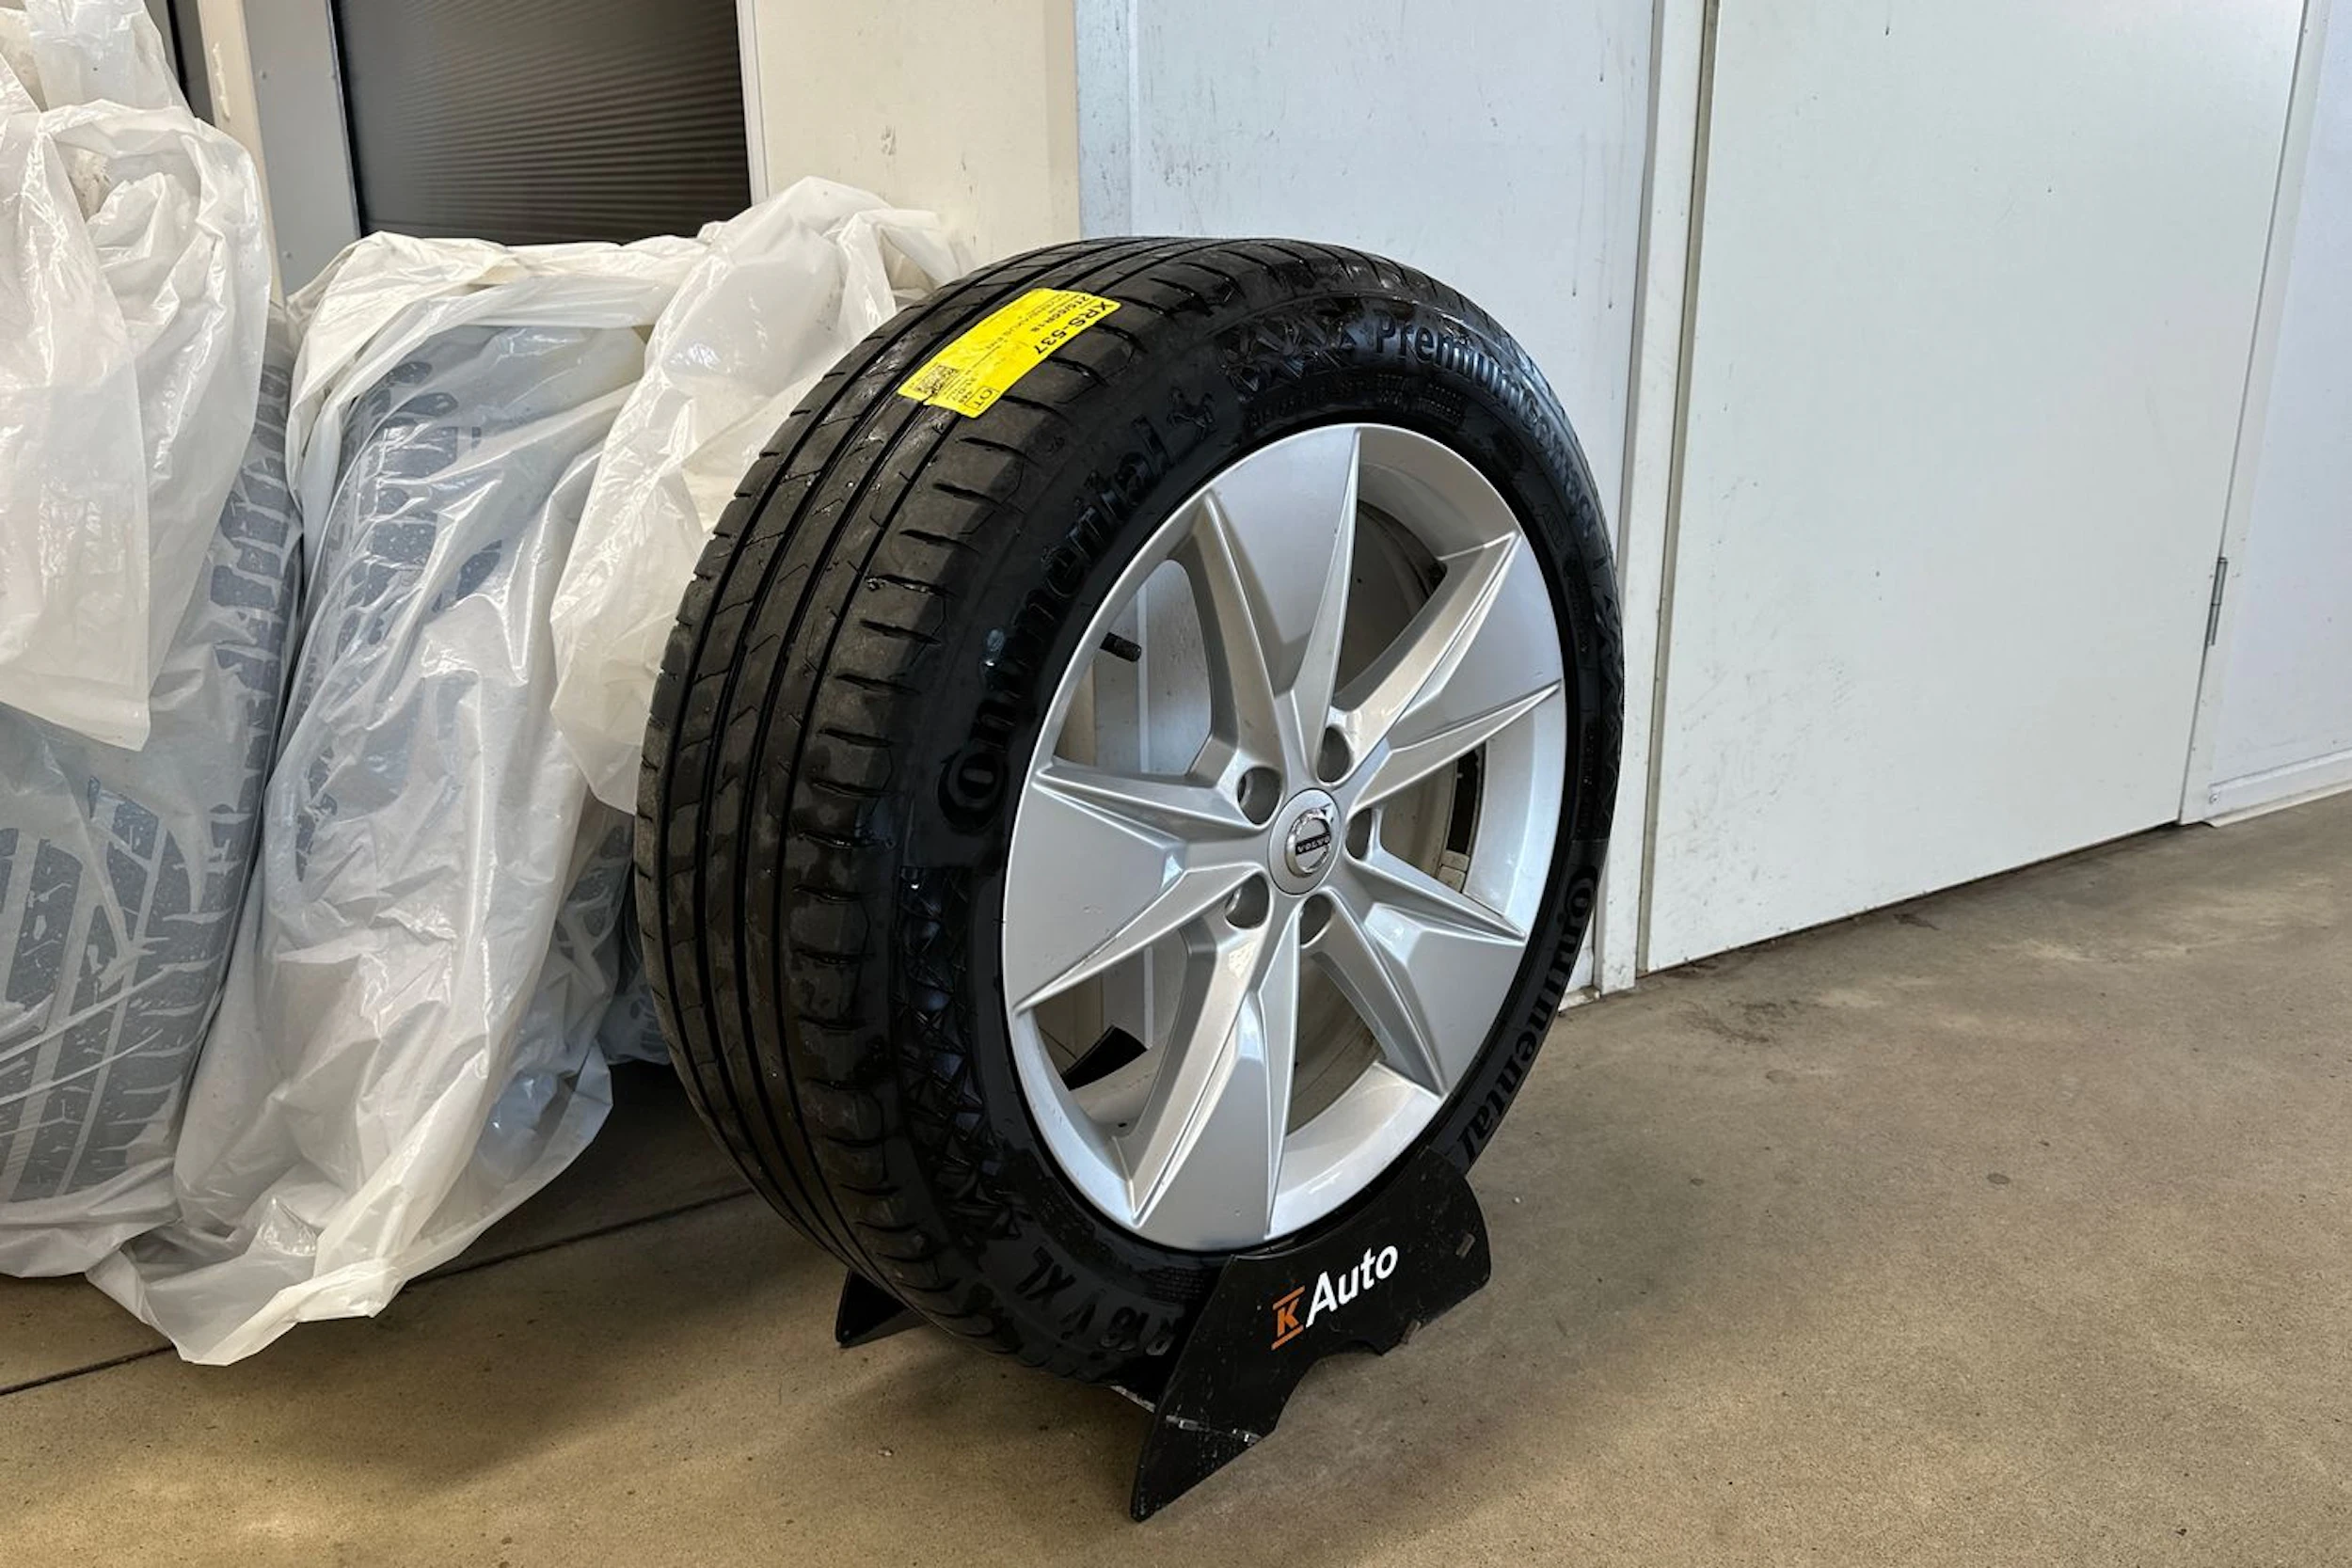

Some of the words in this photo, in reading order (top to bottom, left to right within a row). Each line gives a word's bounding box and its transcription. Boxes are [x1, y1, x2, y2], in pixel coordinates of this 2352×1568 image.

[1034, 301, 1114, 355] XRS-537
[1296, 835, 1330, 853] VOLVO
[1457, 865, 1597, 1160] Continental
[1014, 1245, 1077, 1311] XL
[1305, 1244, 1399, 1329] Auto
